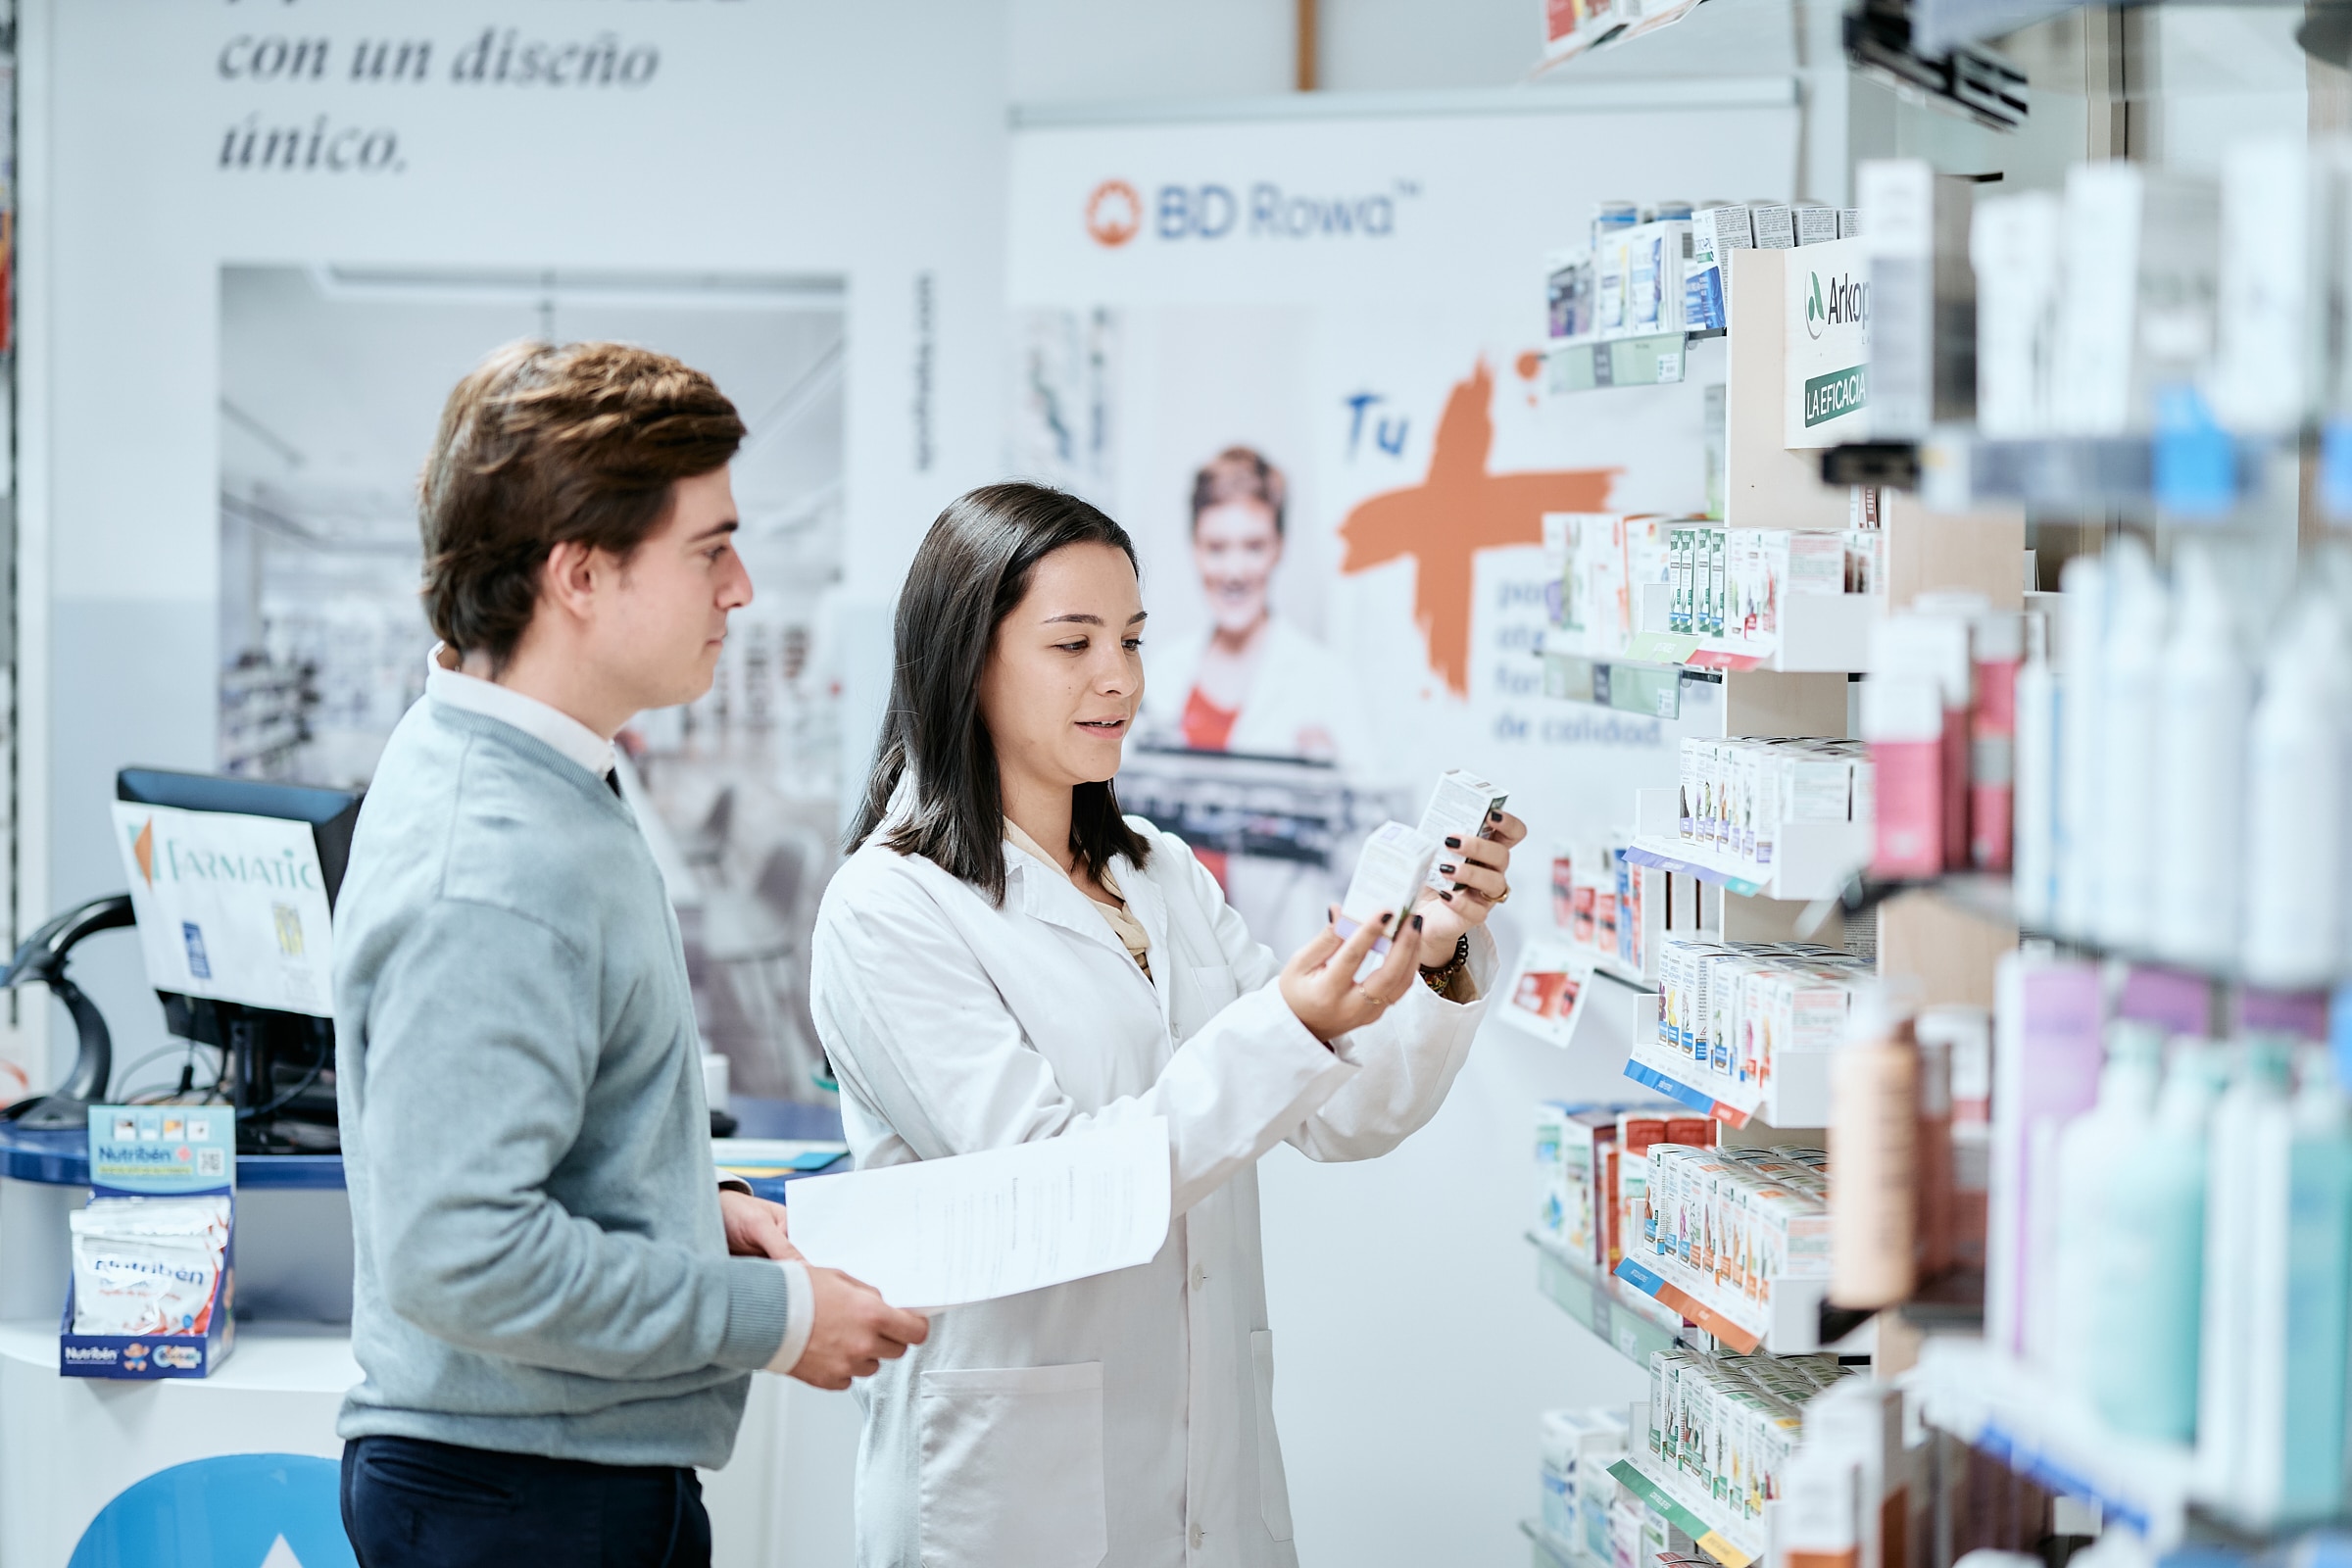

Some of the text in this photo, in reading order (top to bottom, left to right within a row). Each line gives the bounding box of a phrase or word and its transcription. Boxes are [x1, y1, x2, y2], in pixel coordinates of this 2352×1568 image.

[217, 25, 662, 90] con un diseño
[218, 110, 408, 173] único.
[1157, 184, 1237, 239] BD
[1344, 392, 1409, 458] Tu
[1807, 372, 1867, 419] LA EFICACIA
